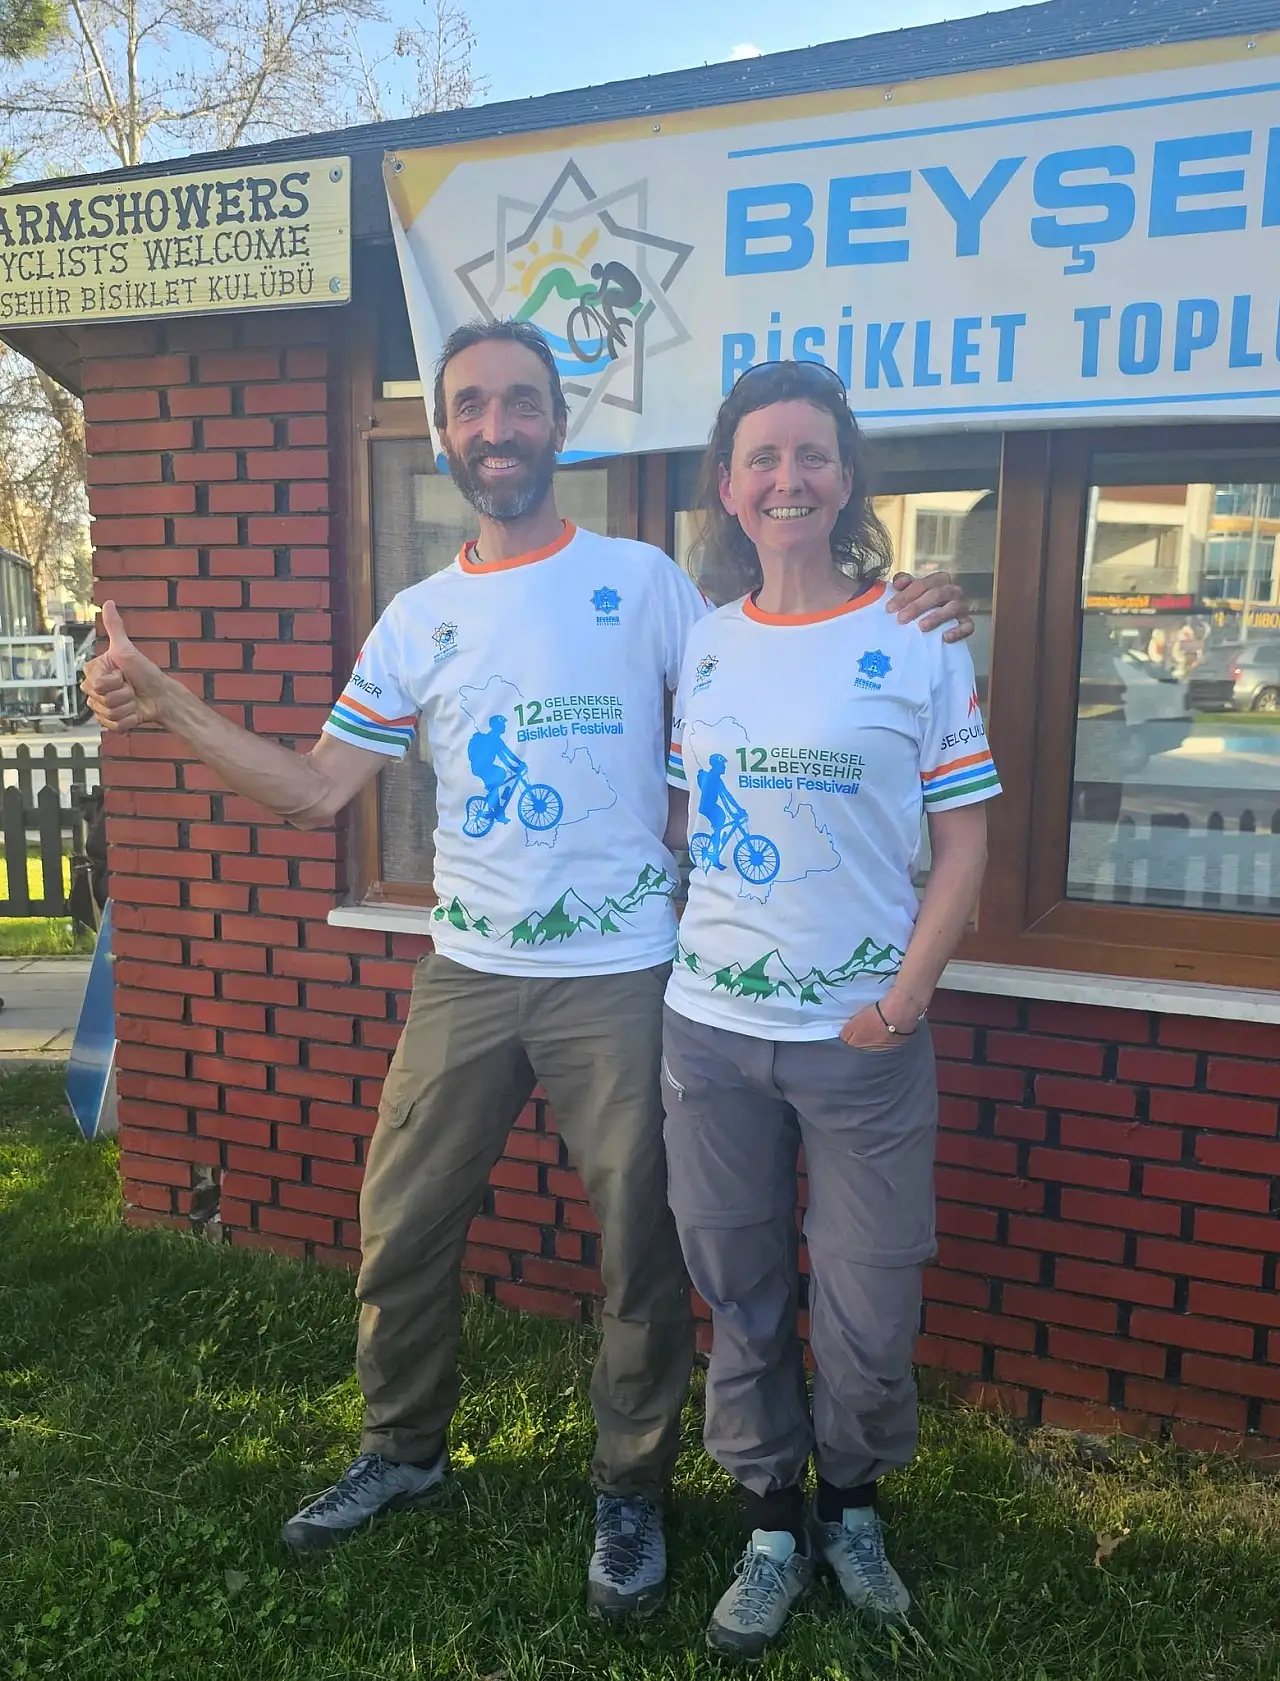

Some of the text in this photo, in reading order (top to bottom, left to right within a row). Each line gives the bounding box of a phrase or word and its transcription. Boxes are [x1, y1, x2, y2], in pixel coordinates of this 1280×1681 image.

[725, 127, 1280, 276] BEYŞE
[143, 223, 311, 271] WELCOME
[81, 276, 198, 313] BİSİKLET
[208, 262, 314, 302] KULÜBÜ
[721, 293, 1280, 398] BİSİKLET TOPL
[544, 695, 623, 708] GELENEKSEL
[552, 706, 624, 722] BEYŞEHİR
[516, 721, 624, 743] Bisiklet Festivali
[770, 747, 866, 766] GELENEKSEL
[778, 760, 863, 781] BEYŞEHİR
[738, 775, 860, 795] Bisiklet Festivali
